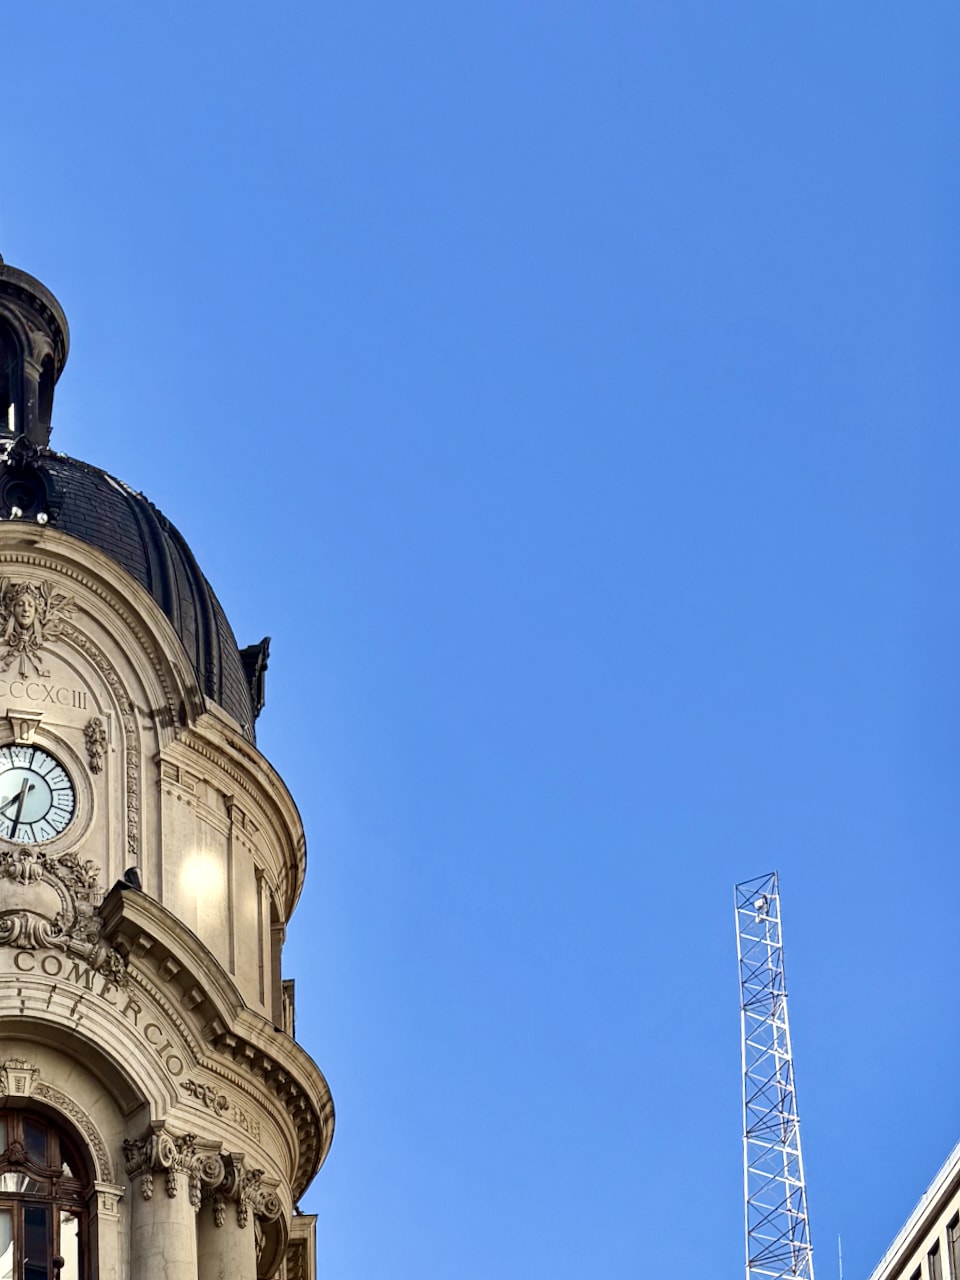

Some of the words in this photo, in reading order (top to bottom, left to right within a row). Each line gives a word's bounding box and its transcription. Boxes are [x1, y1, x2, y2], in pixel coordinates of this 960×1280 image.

[12, 750, 33, 763] XII
[51, 773, 65, 786] II
[57, 792, 70, 808] III
[17, 828, 31, 839] VI
[13, 951, 185, 1077] COMERCIO
